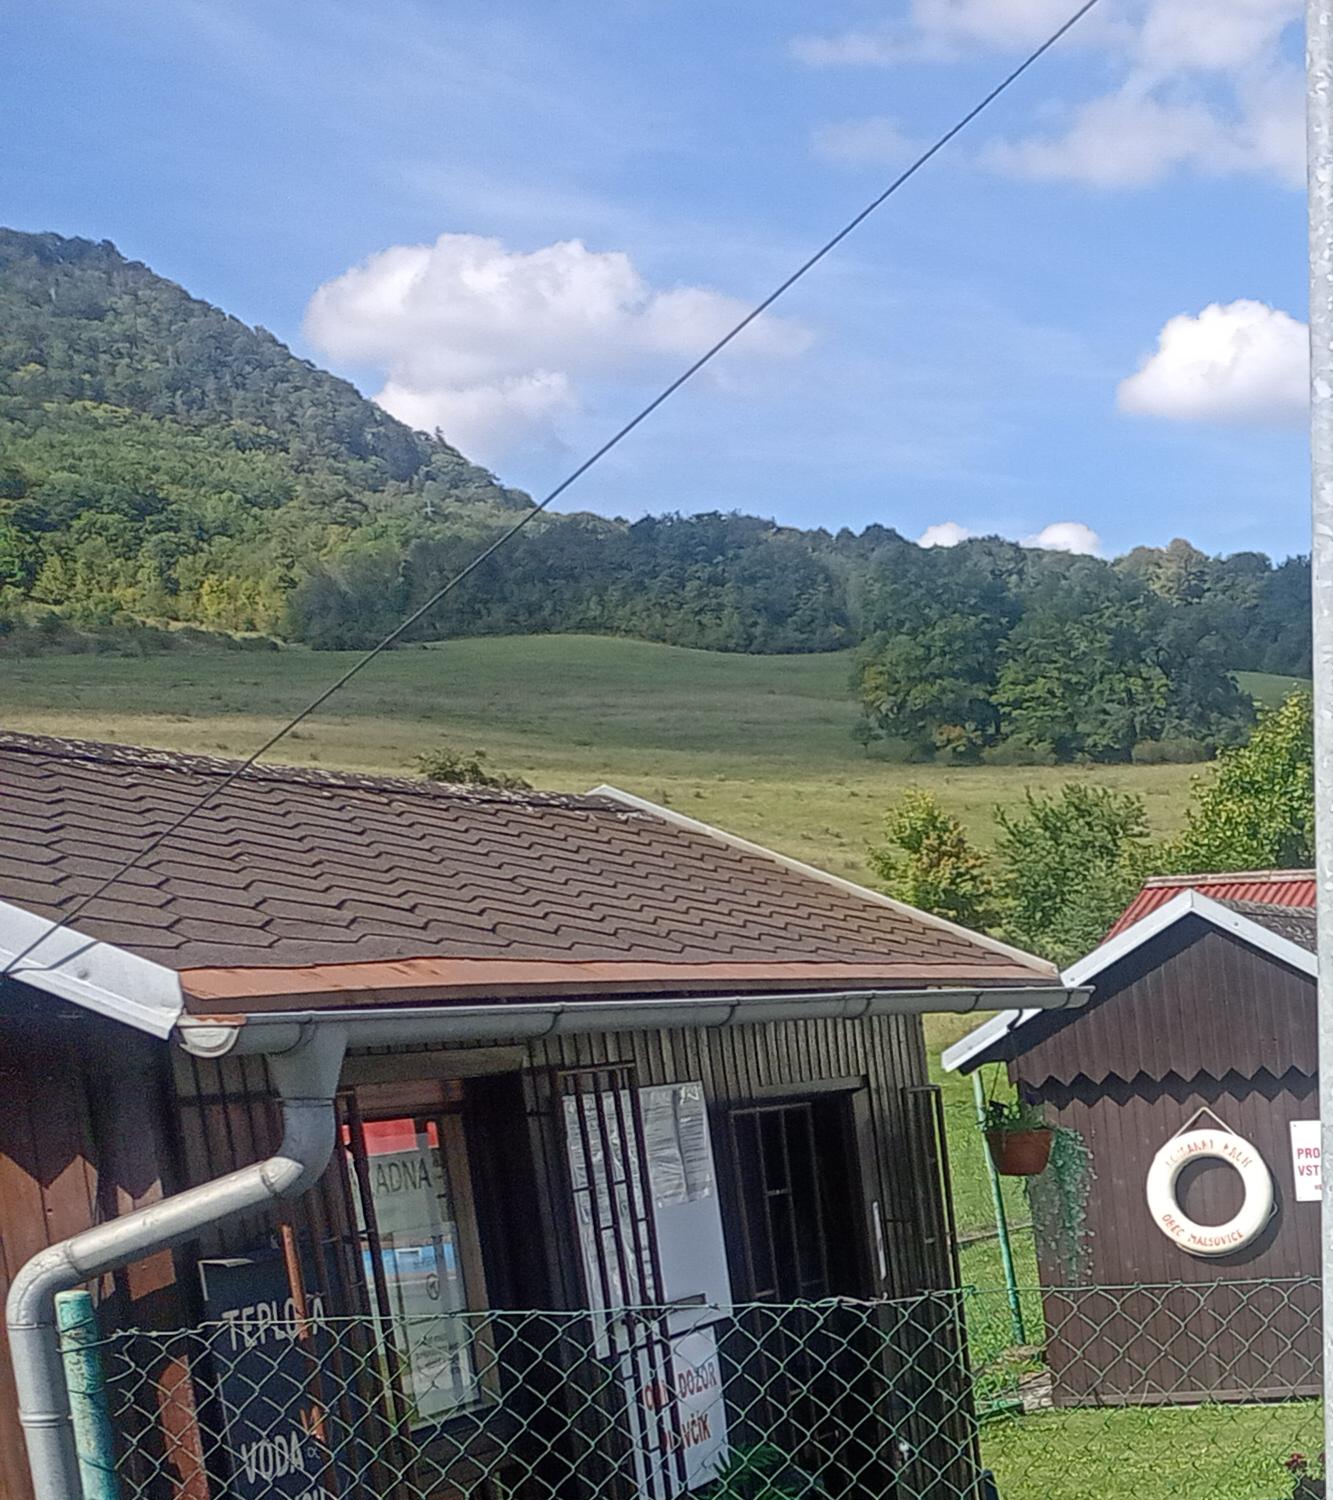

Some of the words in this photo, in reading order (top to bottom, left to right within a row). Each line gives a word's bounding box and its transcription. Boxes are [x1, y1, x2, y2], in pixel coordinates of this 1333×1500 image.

[1162, 1213, 1185, 1237] OBEC
[222, 1297, 324, 1352] TEPLOA
[241, 1430, 305, 1484] VODA
